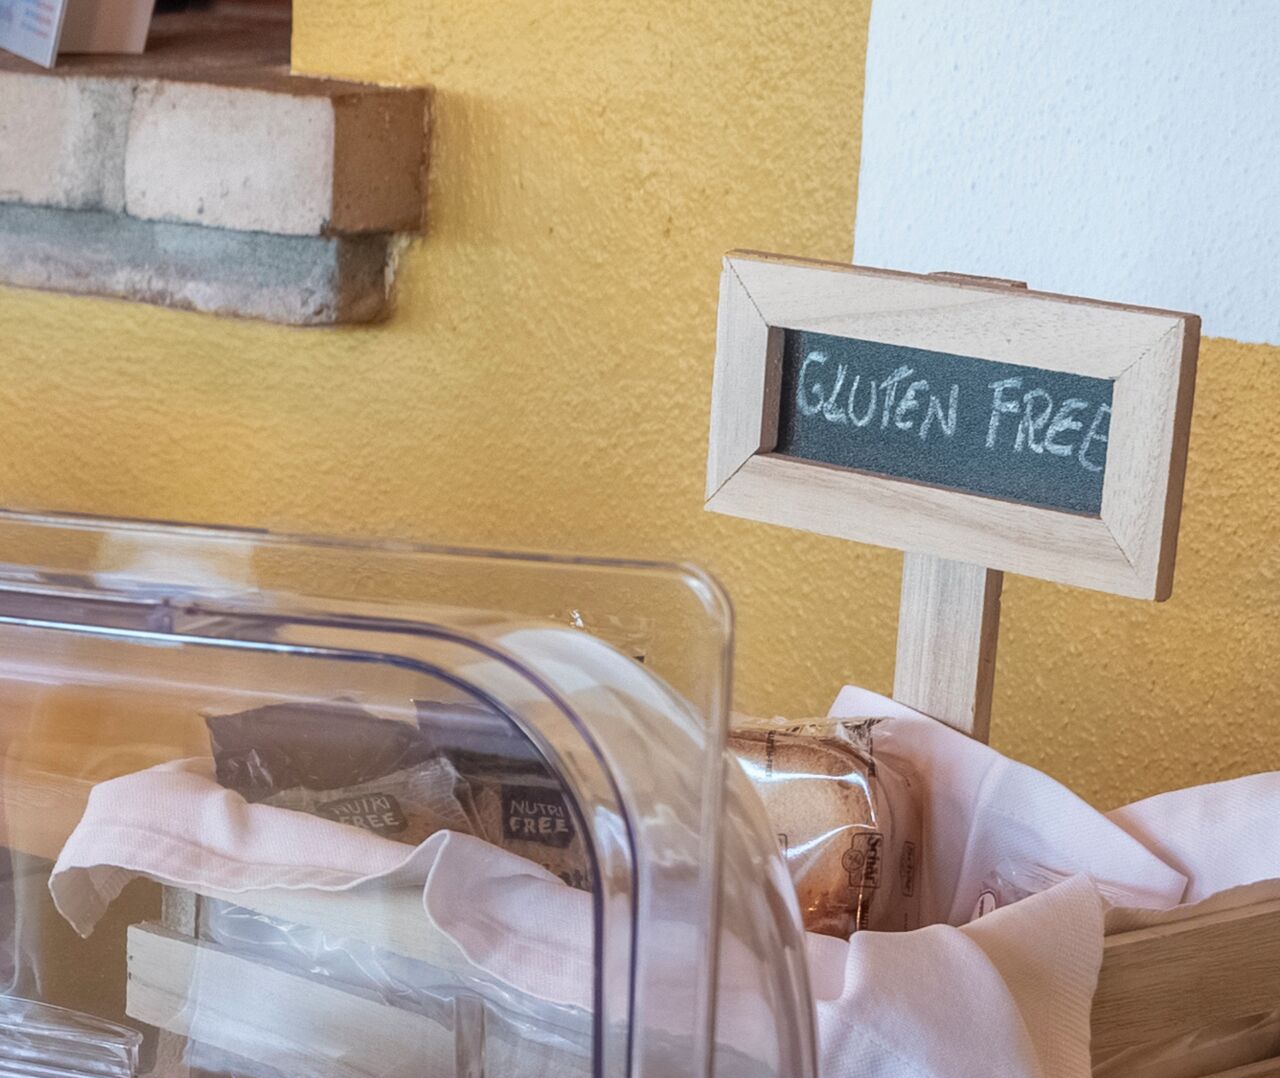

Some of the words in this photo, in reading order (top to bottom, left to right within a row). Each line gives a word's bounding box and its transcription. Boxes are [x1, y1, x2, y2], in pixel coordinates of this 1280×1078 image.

[796, 350, 959, 440] GLUTEN
[509, 800, 564, 816] NUTRI
[509, 818, 570, 834] FREE
